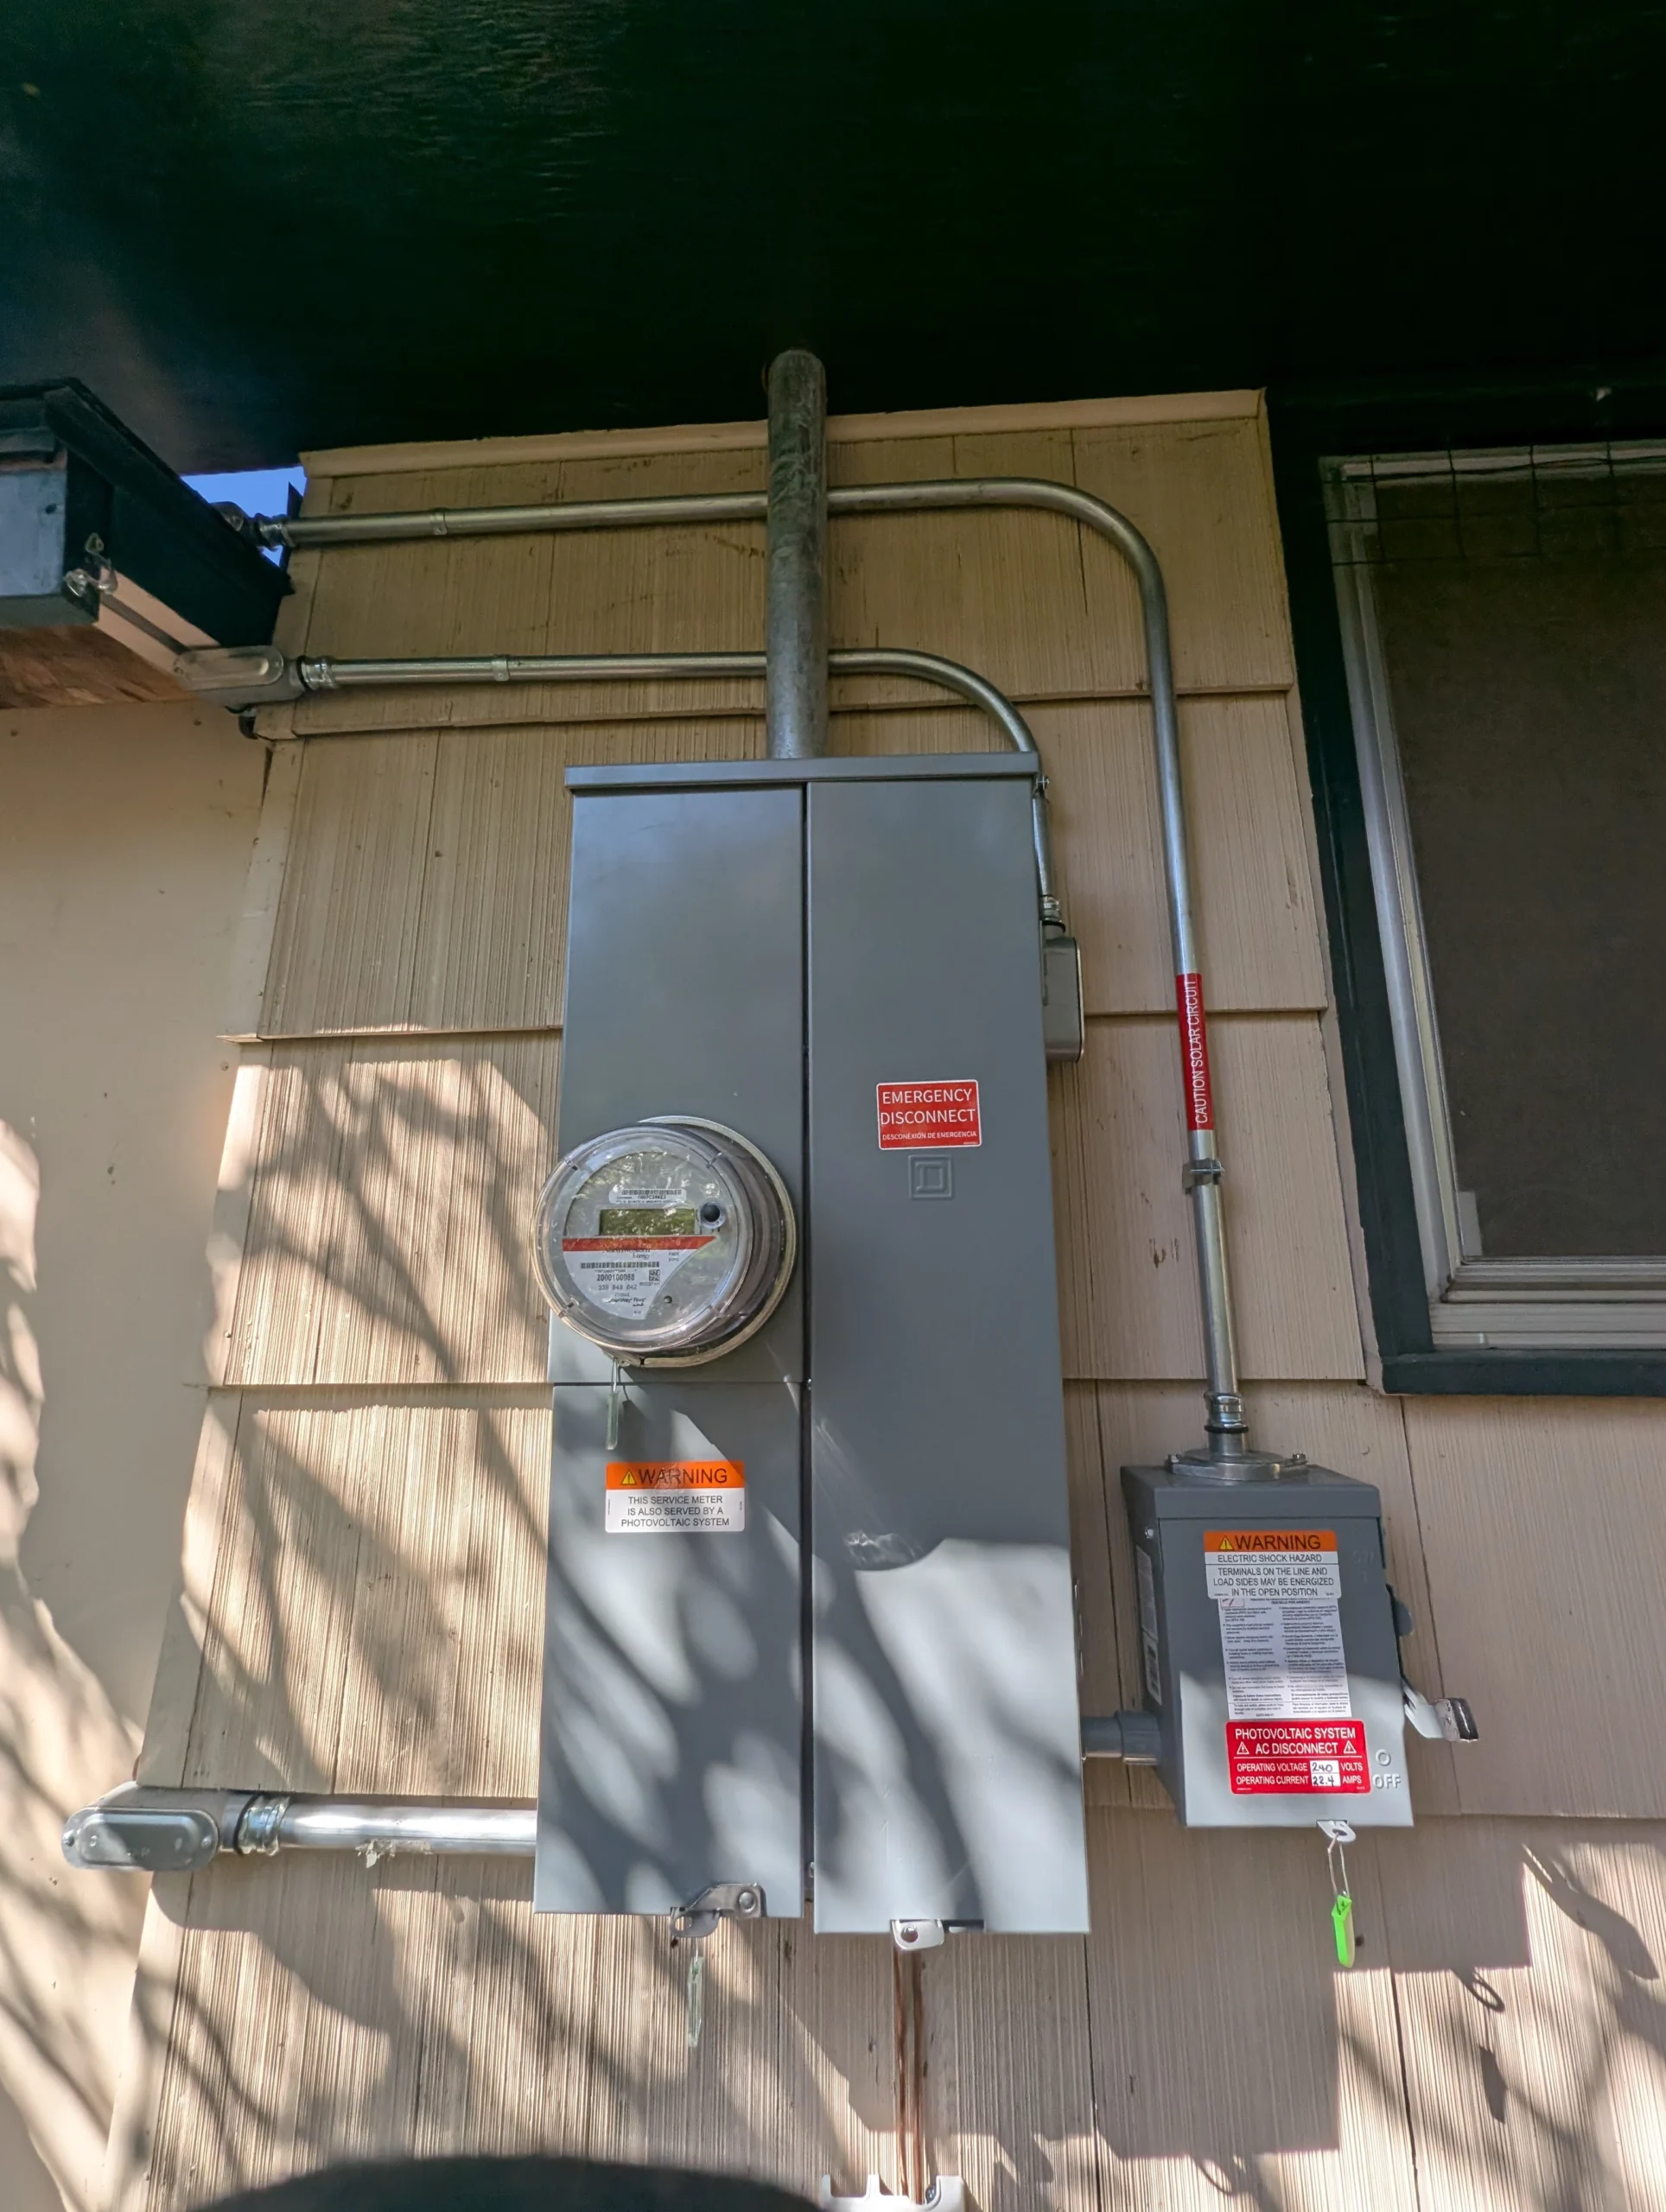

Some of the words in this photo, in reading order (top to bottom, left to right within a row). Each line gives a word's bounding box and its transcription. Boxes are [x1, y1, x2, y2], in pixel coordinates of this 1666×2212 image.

[1185, 980, 1199, 1026] CIRCUIT
[1188, 1028, 1203, 1068] SOLAR
[882, 1089, 972, 1104] EMERGENCY
[1192, 1071, 1208, 1124] CAUTION
[881, 1109, 976, 1125] DISCONNECT
[882, 1132, 926, 1141] DESCONEXIÓN
[639, 1468, 728, 1484] WARNING
[651, 1496, 690, 1504] SERVICE
[621, 1518, 691, 1527] PHOTOVOLTAIC
[693, 1517, 729, 1526] SYSTEM
[1235, 1535, 1321, 1550] WARNING
[1218, 1554, 1257, 1563] ELECTRIC
[1258, 1554, 1288, 1563] SHOCK
[1289, 1554, 1322, 1562] HAZARD
[1218, 1567, 1261, 1576] TERMINALS
[1213, 1578, 1234, 1586] LOAD
[1236, 1578, 1259, 1586] SIDES
[1231, 1588, 1239, 1597] IN
[1241, 1588, 1256, 1597] THE
[1258, 1588, 1280, 1597] OPEN
[1281, 1587, 1318, 1596] POSITION
[1235, 1727, 1313, 1739] PHOTOVOLTAIC
[1314, 1727, 1356, 1738] SYSTEM
[1256, 1744, 1270, 1754] AC
[1272, 1742, 1339, 1754] DISCONNECT
[1277, 1763, 1307, 1771] VOLTAGE
[1312, 1763, 1332, 1772] 240
[1340, 1763, 1363, 1771] VOLTS
[1236, 1776, 1275, 1784] OPERATING
[1276, 1776, 1309, 1784] CURRENT
[1313, 1776, 1335, 1786] 22.4
[1342, 1776, 1362, 1784] AMPS
[1372, 1773, 1402, 1789] OFF
